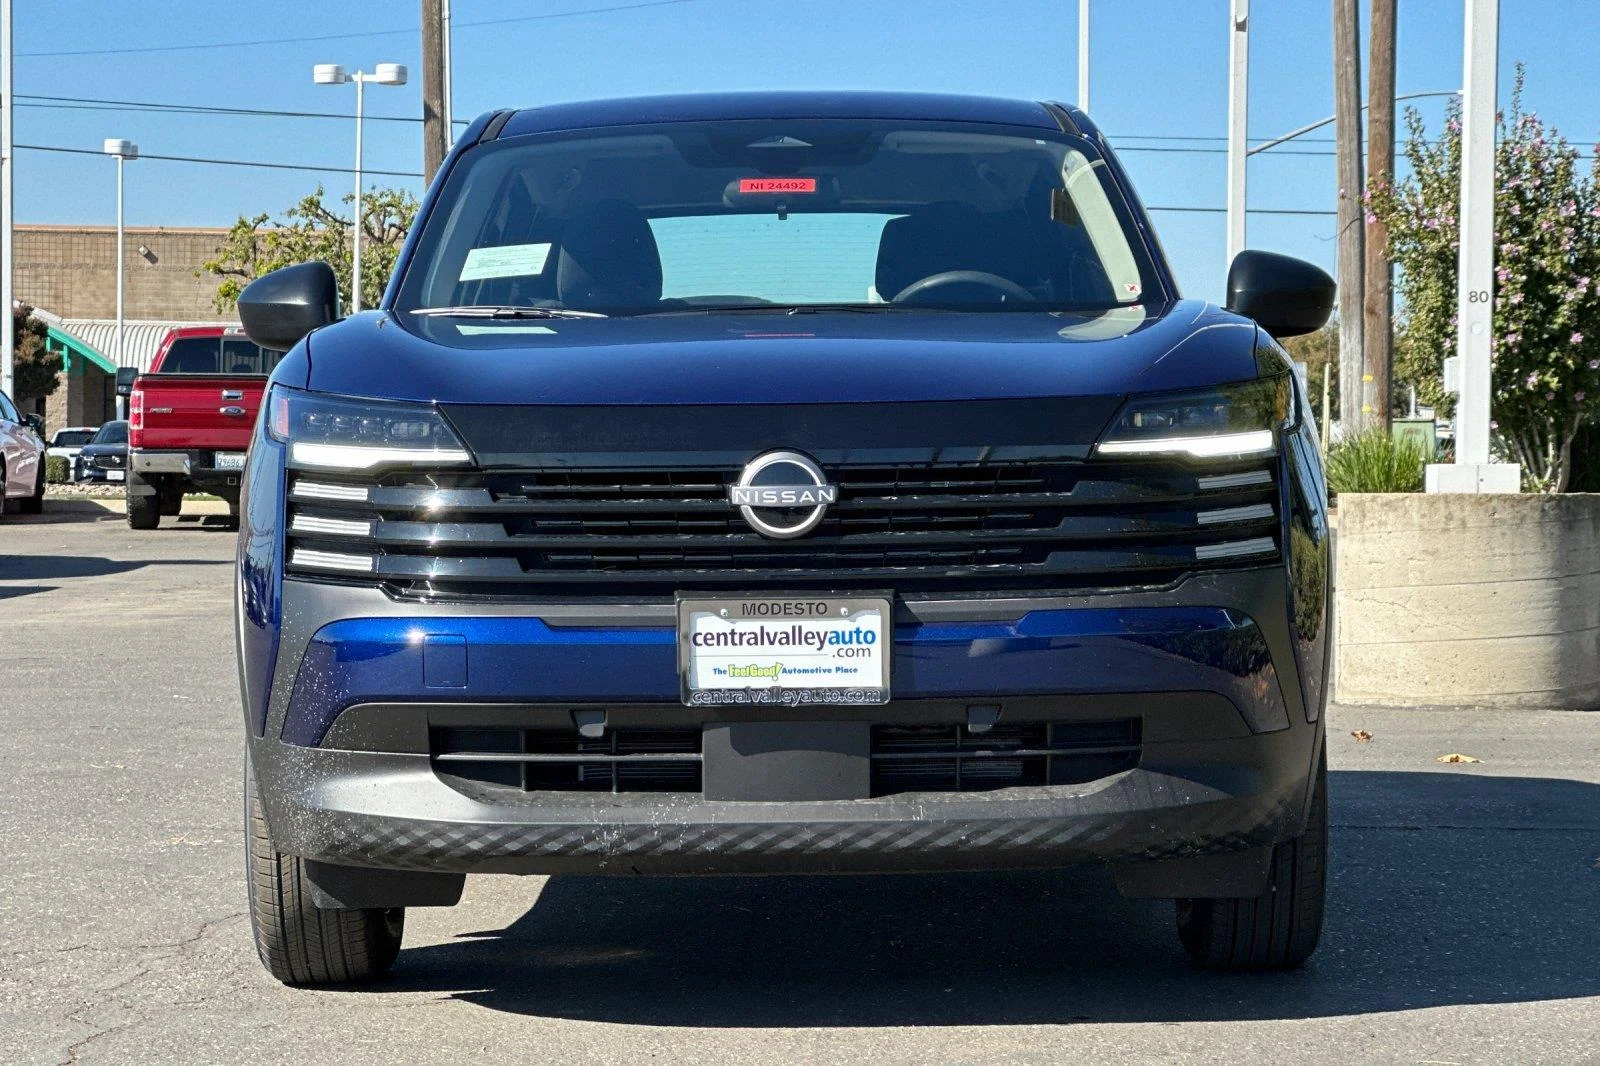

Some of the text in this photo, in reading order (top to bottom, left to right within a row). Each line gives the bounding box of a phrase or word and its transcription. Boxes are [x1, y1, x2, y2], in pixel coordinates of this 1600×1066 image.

[750, 182, 807, 190] NI 24492
[1469, 290, 1489, 303] 80
[735, 488, 835, 503] NISSAN
[741, 602, 829, 616] MODESTO
[692, 625, 876, 651] centralvalleyauto
[832, 647, 872, 658] .com
[713, 667, 728, 676] The
[781, 666, 833, 675] Automotive
[835, 666, 859, 674] Place
[692, 686, 882, 707] centralvalleyauto.com
